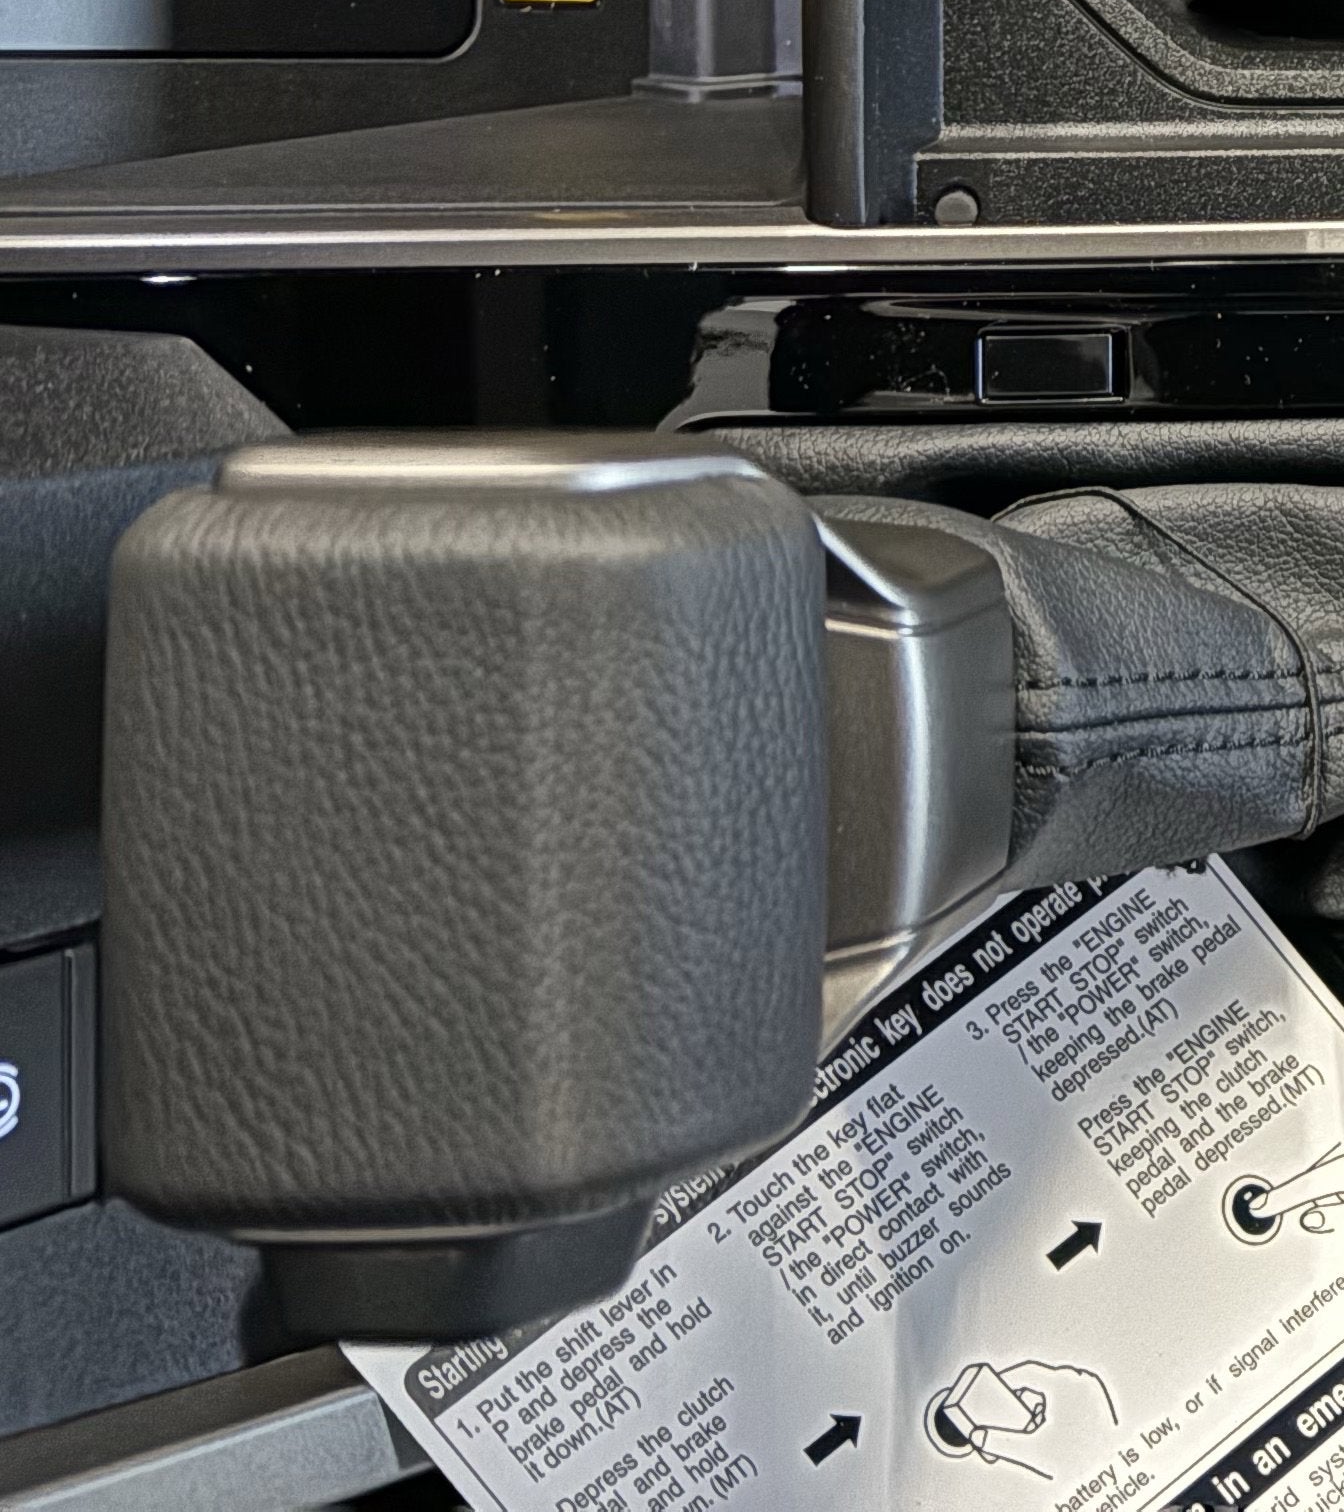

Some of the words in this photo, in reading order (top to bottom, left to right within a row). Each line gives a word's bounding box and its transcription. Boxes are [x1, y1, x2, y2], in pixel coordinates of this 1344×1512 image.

[965, 1020, 989, 1040] 3.
[985, 980, 1040, 1025] Press
[1039, 955, 1073, 983] the
[1072, 887, 1156, 952] "ENGINE
[1002, 986, 1063, 1043] START
[1069, 937, 1124, 991] STOP"
[1134, 898, 1189, 944] switch
[1030, 1023, 1105, 1083] keeping
[1103, 998, 1136, 1026] the
[1135, 958, 1189, 1001] brake
[1191, 913, 1242, 965] pedal
[1057, 955, 1140, 1025] "POWER"
[1148, 916, 1209, 962] switch,
[418, 1338, 508, 1399] Starting
[874, 1003, 922, 1045] key
[922, 964, 974, 1010] does
[972, 930, 1013, 971] not
[1011, 880, 1082, 942] operate
[1077, 1094, 1132, 1139] Press
[1132, 1068, 1165, 1095] the
[1165, 999, 1250, 1064] "ENGINE
[1093, 1098, 1155, 1155] START
[1160, 1049, 1215, 1103] STOP"
[1224, 1009, 1286, 1055] switch,
[1107, 1116, 1181, 1176] keeping
[1179, 1092, 1212, 1119] the
[1215, 1049, 1268, 1093] clutch
[1125, 1146, 1176, 1199] pedal
[1174, 1115, 1215, 1153] and
[1214, 1095, 1247, 1122] the
[1247, 1054, 1299, 1097] brake
[707, 1222, 732, 1244] 2.
[726, 1172, 795, 1223] Touch
[791, 1144, 830, 1176] the
[826, 1111, 878, 1149] key
[866, 1083, 905, 1118] flat
[747, 1184, 818, 1247] against
[817, 1159, 852, 1189] the
[853, 1084, 944, 1155] "ENGINE
[762, 1205, 827, 1266] START
[834, 1151, 894, 1209] STOP"
[906, 1106, 964, 1155] switch
[791, 1285, 817, 1306] in
[820, 1238, 873, 1286] direct
[878, 1181, 945, 1240] contact
[947, 1150, 988, 1184] with
[822, 1170, 912, 1247] "POWER"
[920, 1128, 985, 1178] switch,
[1136, 1165, 1192, 1218] pedal
[807, 1305, 834, 1327] it,
[836, 1265, 877, 1305] until
[877, 1216, 940, 1270] buzzer
[948, 1162, 1011, 1217] sounds
[827, 1306, 864, 1344] and
[866, 1254, 934, 1311] ignition
[939, 1229, 971, 1254] on.
[457, 1418, 480, 1438] 1.
[476, 1384, 520, 1423] Put
[514, 1360, 552, 1393] the
[555, 1320, 602, 1363] shift
[599, 1279, 652, 1327] lever
[649, 1264, 677, 1288] in
[492, 1419, 509, 1443] P
[518, 1384, 558, 1424] and
[560, 1327, 635, 1391] depress
[636, 1298, 671, 1329] the
[507, 1416, 565, 1464] brake
[569, 1365, 628, 1422] pedal
[629, 1331, 667, 1371] and
[665, 1296, 712, 1340] hold
[1054, 1463, 1117, 1512] battery
[1118, 1447, 1139, 1467] is
[1139, 1416, 1180, 1449] low,
[1185, 1391, 1204, 1413] or
[1205, 1373, 1223, 1394] if
[1228, 1328, 1279, 1377] signal
[555, 1453, 638, 1512] Depress
[636, 1426, 672, 1456] the
[677, 1377, 734, 1426] clutch
[633, 1454, 671, 1494] and
[670, 1415, 726, 1462] brake
[647, 1475, 685, 1512] and
[683, 1440, 729, 1483] hold
[1095, 1471, 1155, 1512] ehicle.
[1211, 1471, 1250, 1504] in
[1252, 1436, 1291, 1475] an
